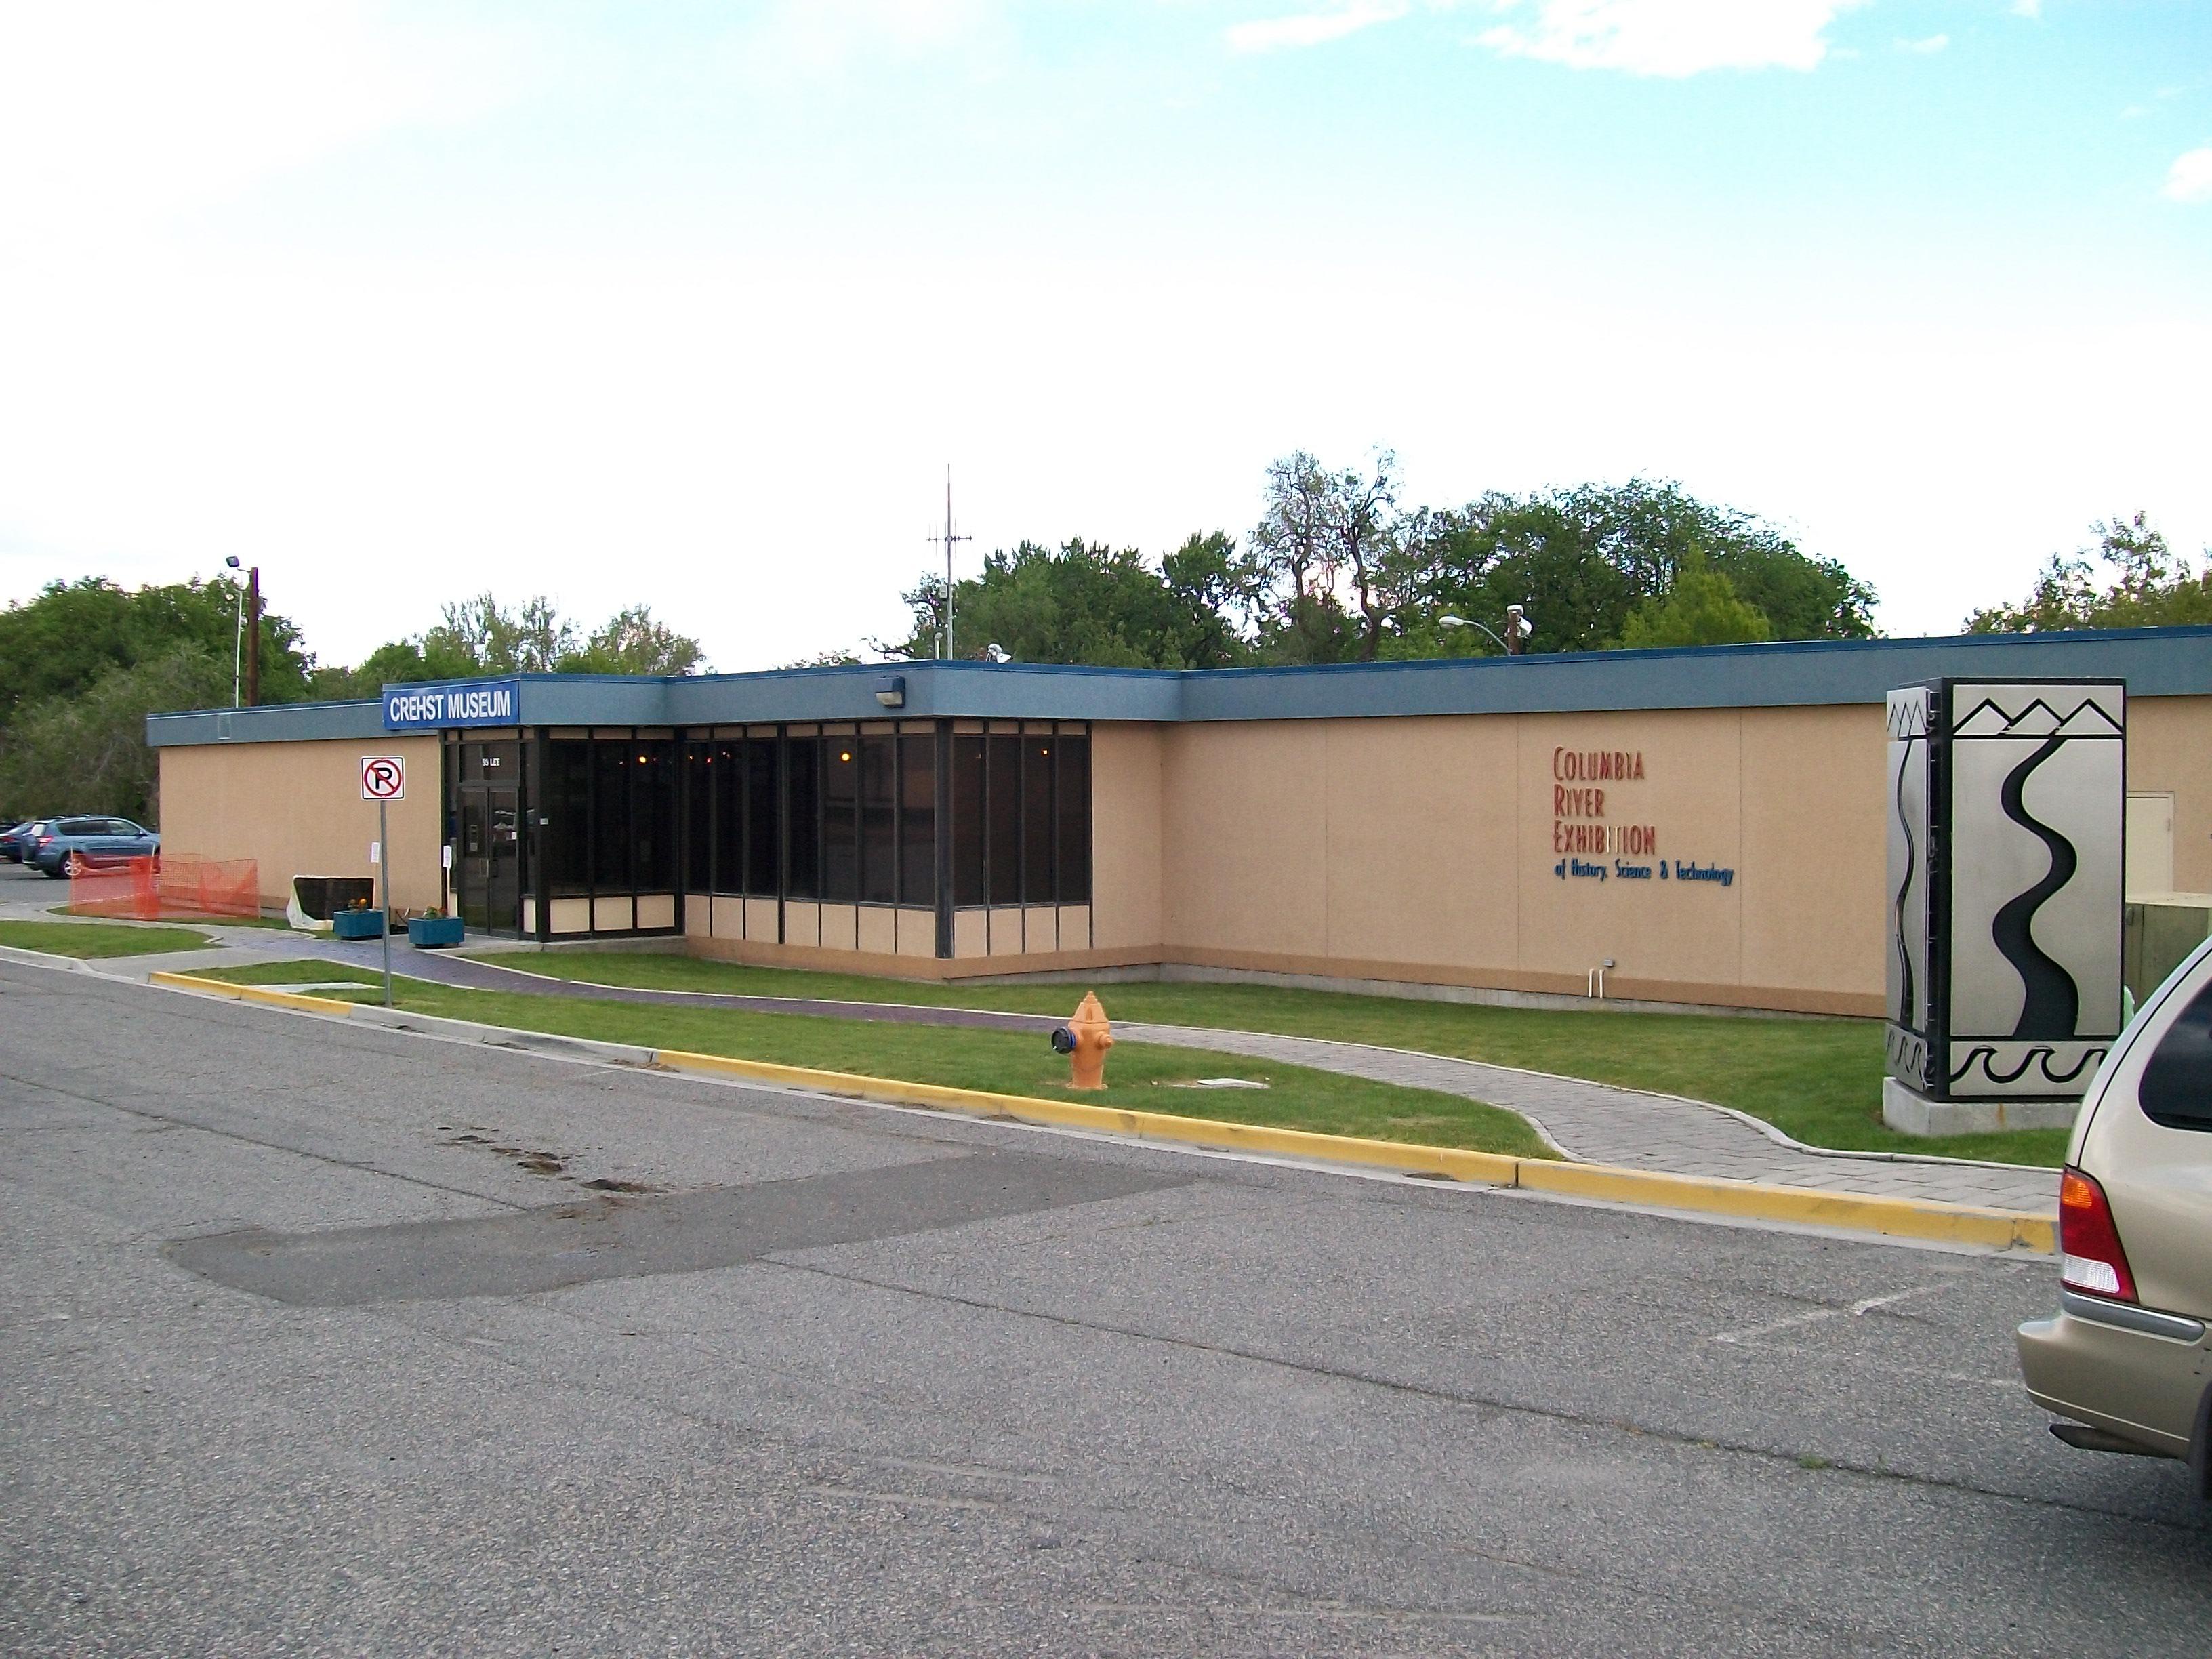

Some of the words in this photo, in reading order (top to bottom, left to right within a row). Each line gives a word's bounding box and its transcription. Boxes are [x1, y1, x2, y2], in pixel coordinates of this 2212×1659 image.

[390, 694, 445, 722] CREHST
[448, 690, 510, 720] MUSEUM
[1553, 746, 1645, 781] COLUMBIA
[1553, 783, 1604, 817] RIVER
[1553, 819, 1655, 855] EXHIBITION
[1554, 857, 1566, 880] of
[1615, 857, 1652, 879] Science
[1659, 859, 1668, 879] &
[1675, 859, 1734, 887] Technology
